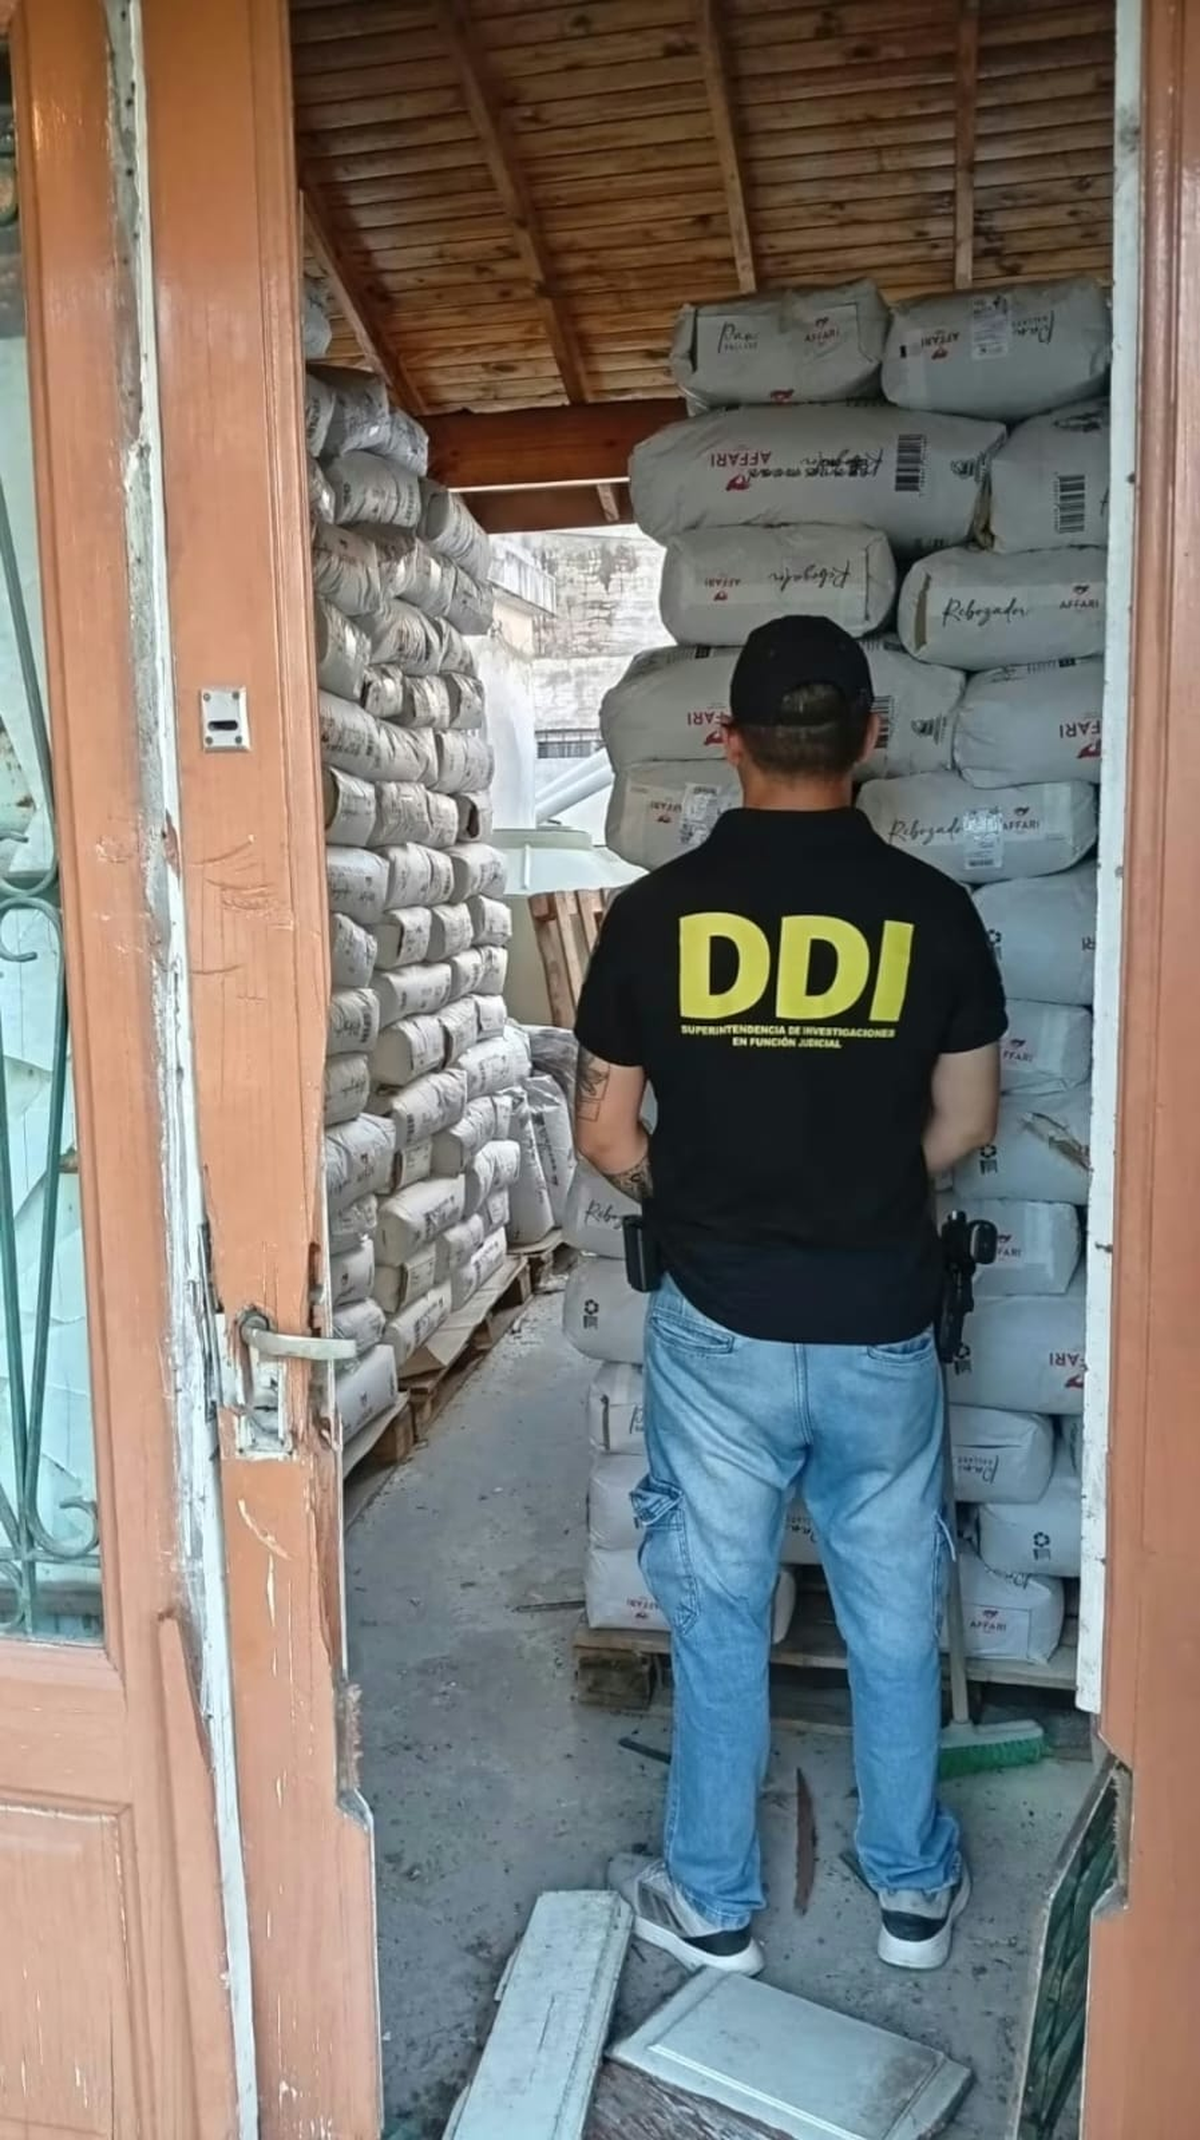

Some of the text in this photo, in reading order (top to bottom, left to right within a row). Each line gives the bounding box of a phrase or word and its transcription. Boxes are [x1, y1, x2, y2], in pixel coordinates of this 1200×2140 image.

[921, 332, 960, 348] AFFARI
[710, 451, 772, 468] AFFARI
[704, 577, 741, 588] AFFARI
[1059, 599, 1099, 609] AFFARI
[687, 711, 727, 727] FARI
[1059, 720, 1102, 740] FARI
[888, 817, 963, 845] Rebozado
[679, 912, 914, 1022] DDI
[680, 1024, 896, 1038] SUPERINTENDENCIA DE INVESTIGACIONES
[732, 1037, 842, 1049] EN FUNCIÓN JUDICIAL
[1003, 1050, 1033, 1062] FFARI
[998, 1248, 1022, 1258] FARI
[1049, 1352, 1083, 1367] ARI
[970, 1621, 1007, 1632] AFFARI
